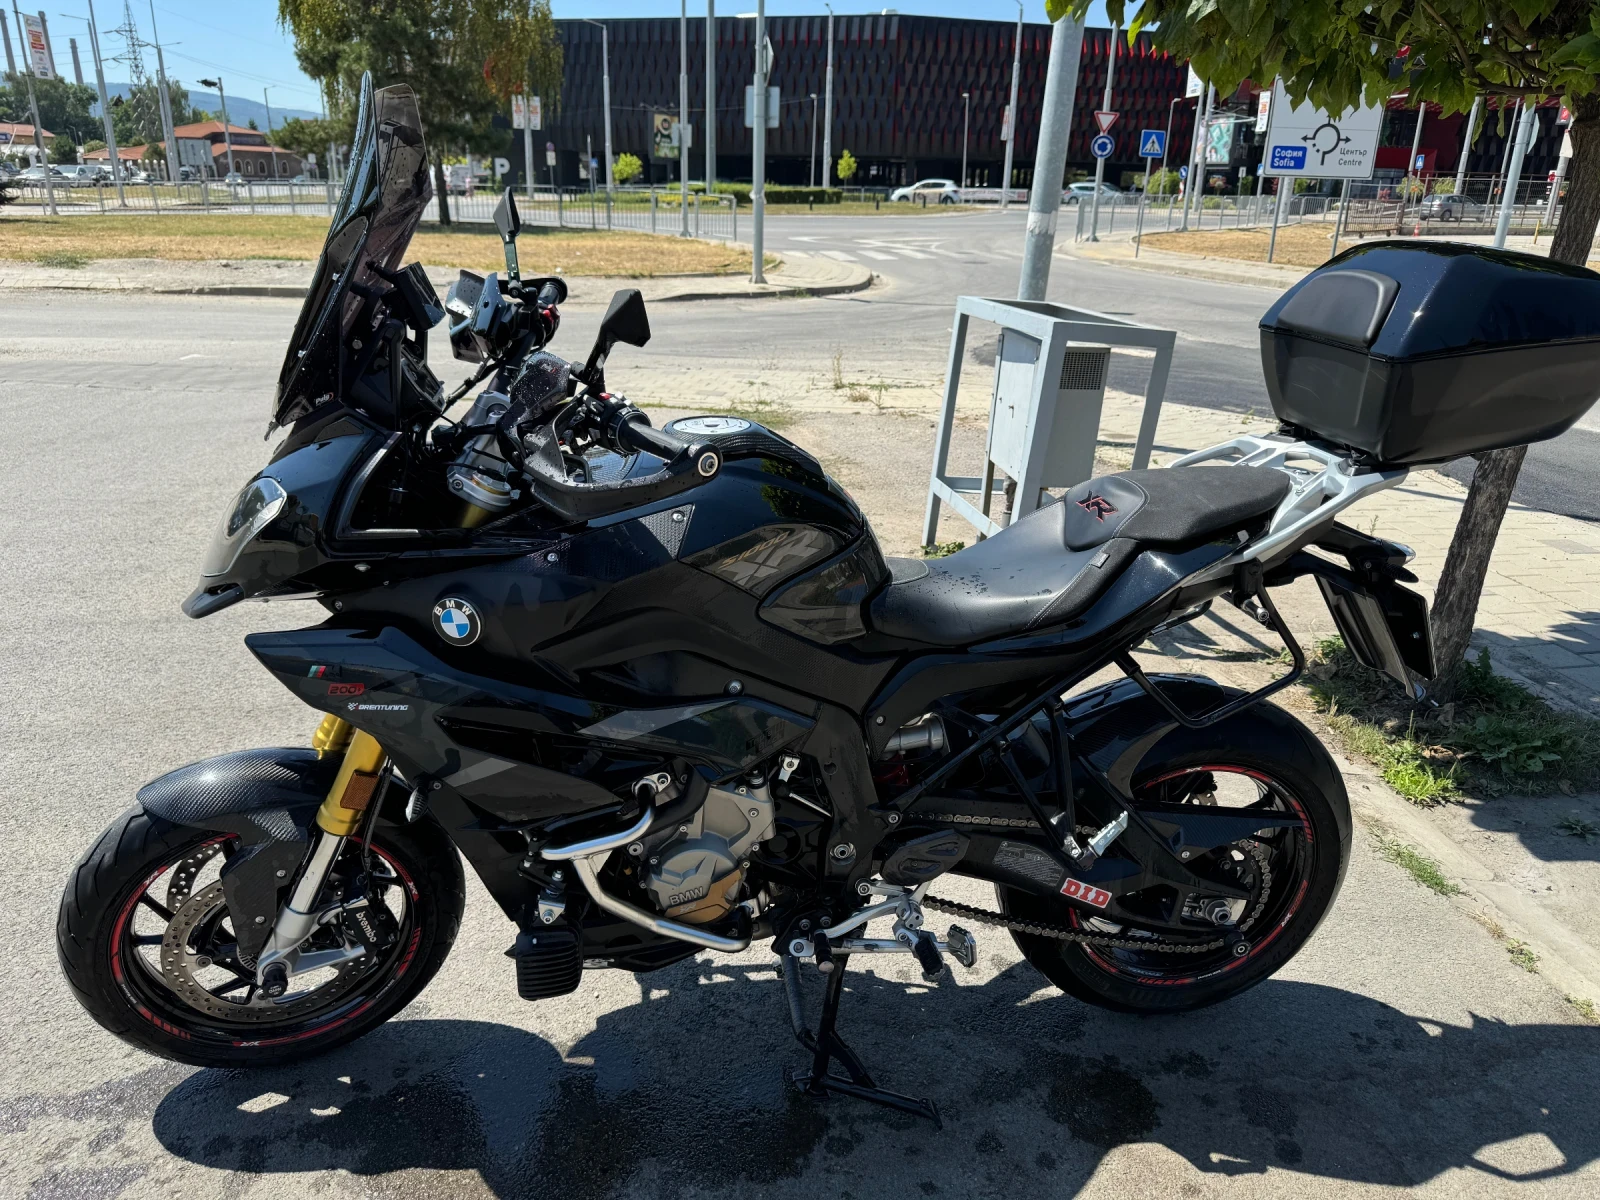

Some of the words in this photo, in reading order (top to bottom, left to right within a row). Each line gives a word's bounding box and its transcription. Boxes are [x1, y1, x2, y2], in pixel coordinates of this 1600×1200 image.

[1274, 148, 1303, 158] София
[1340, 148, 1368, 157] Център
[1273, 157, 1295, 167] Sofia
[1338, 158, 1363, 167] Centre
[1075, 489, 1119, 524] XR
[434, 600, 472, 617] BMW
[669, 886, 704, 905] BMW
[356, 911, 377, 943] brembo
